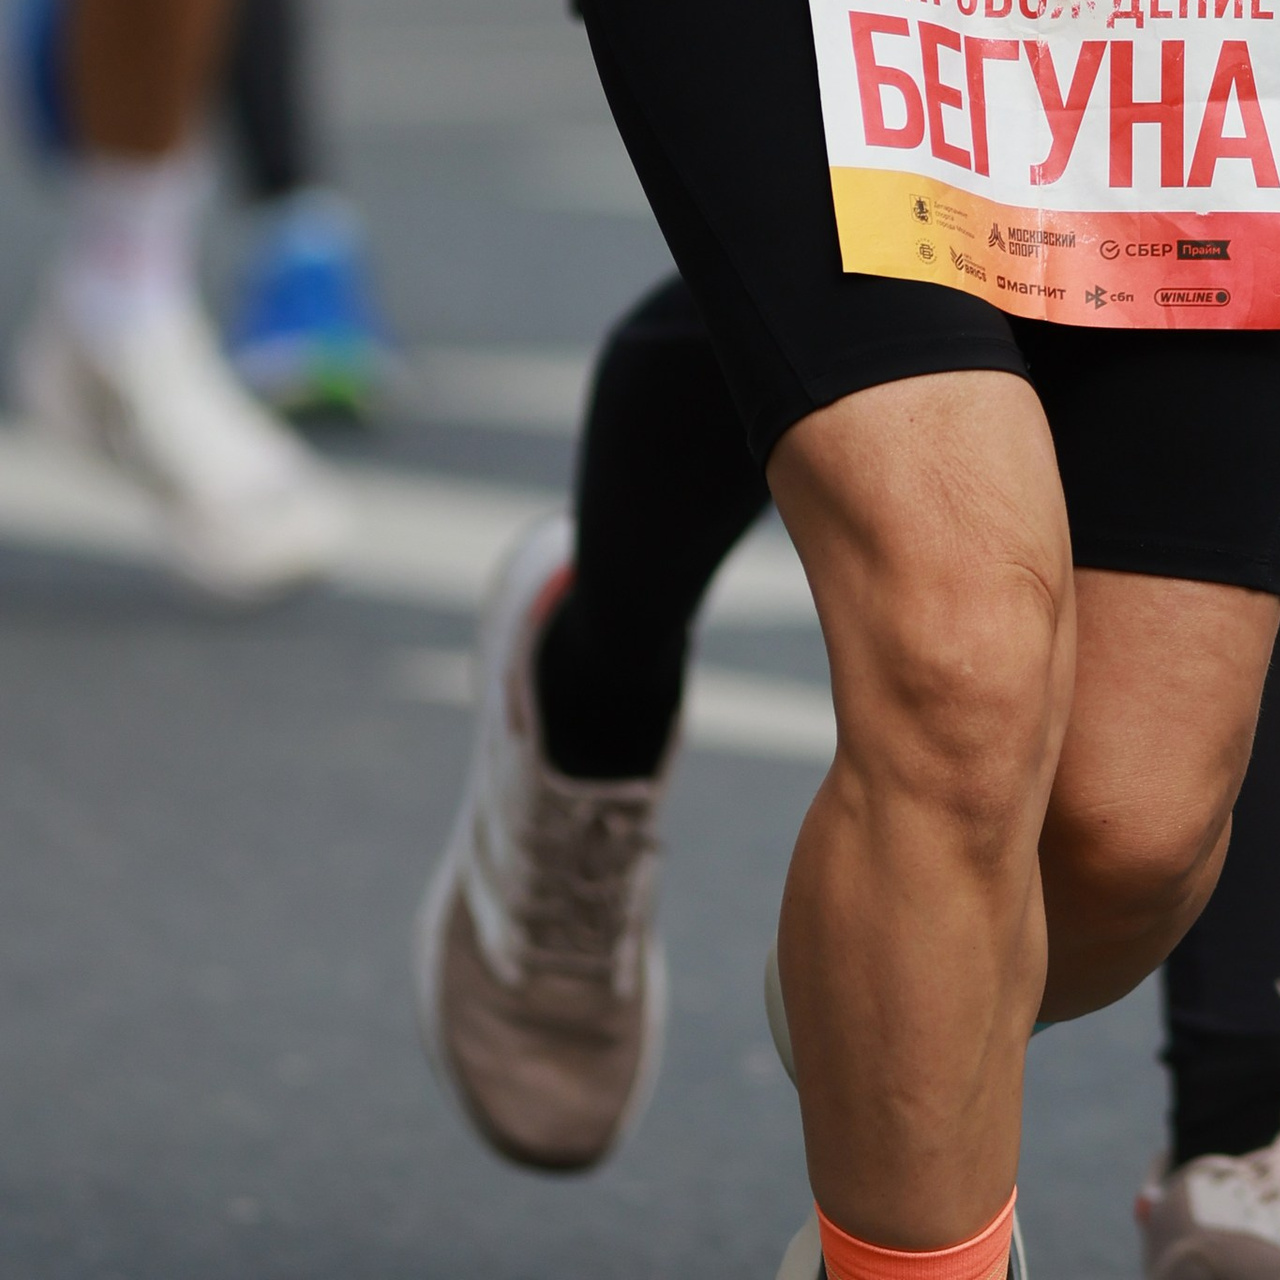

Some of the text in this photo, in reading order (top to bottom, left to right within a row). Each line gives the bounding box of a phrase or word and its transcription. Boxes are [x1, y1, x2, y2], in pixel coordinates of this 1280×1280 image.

[848, 10, 1280, 189] БЕГУНА
[1007, 226, 1076, 249] МОСКОВСКИЙ
[1008, 242, 1041, 259] СПОРТ
[1125, 243, 1221, 257] СБЕР Прайм
[1110, 291, 1134, 303] сбп
[1160, 292, 1214, 303] WINLINE
